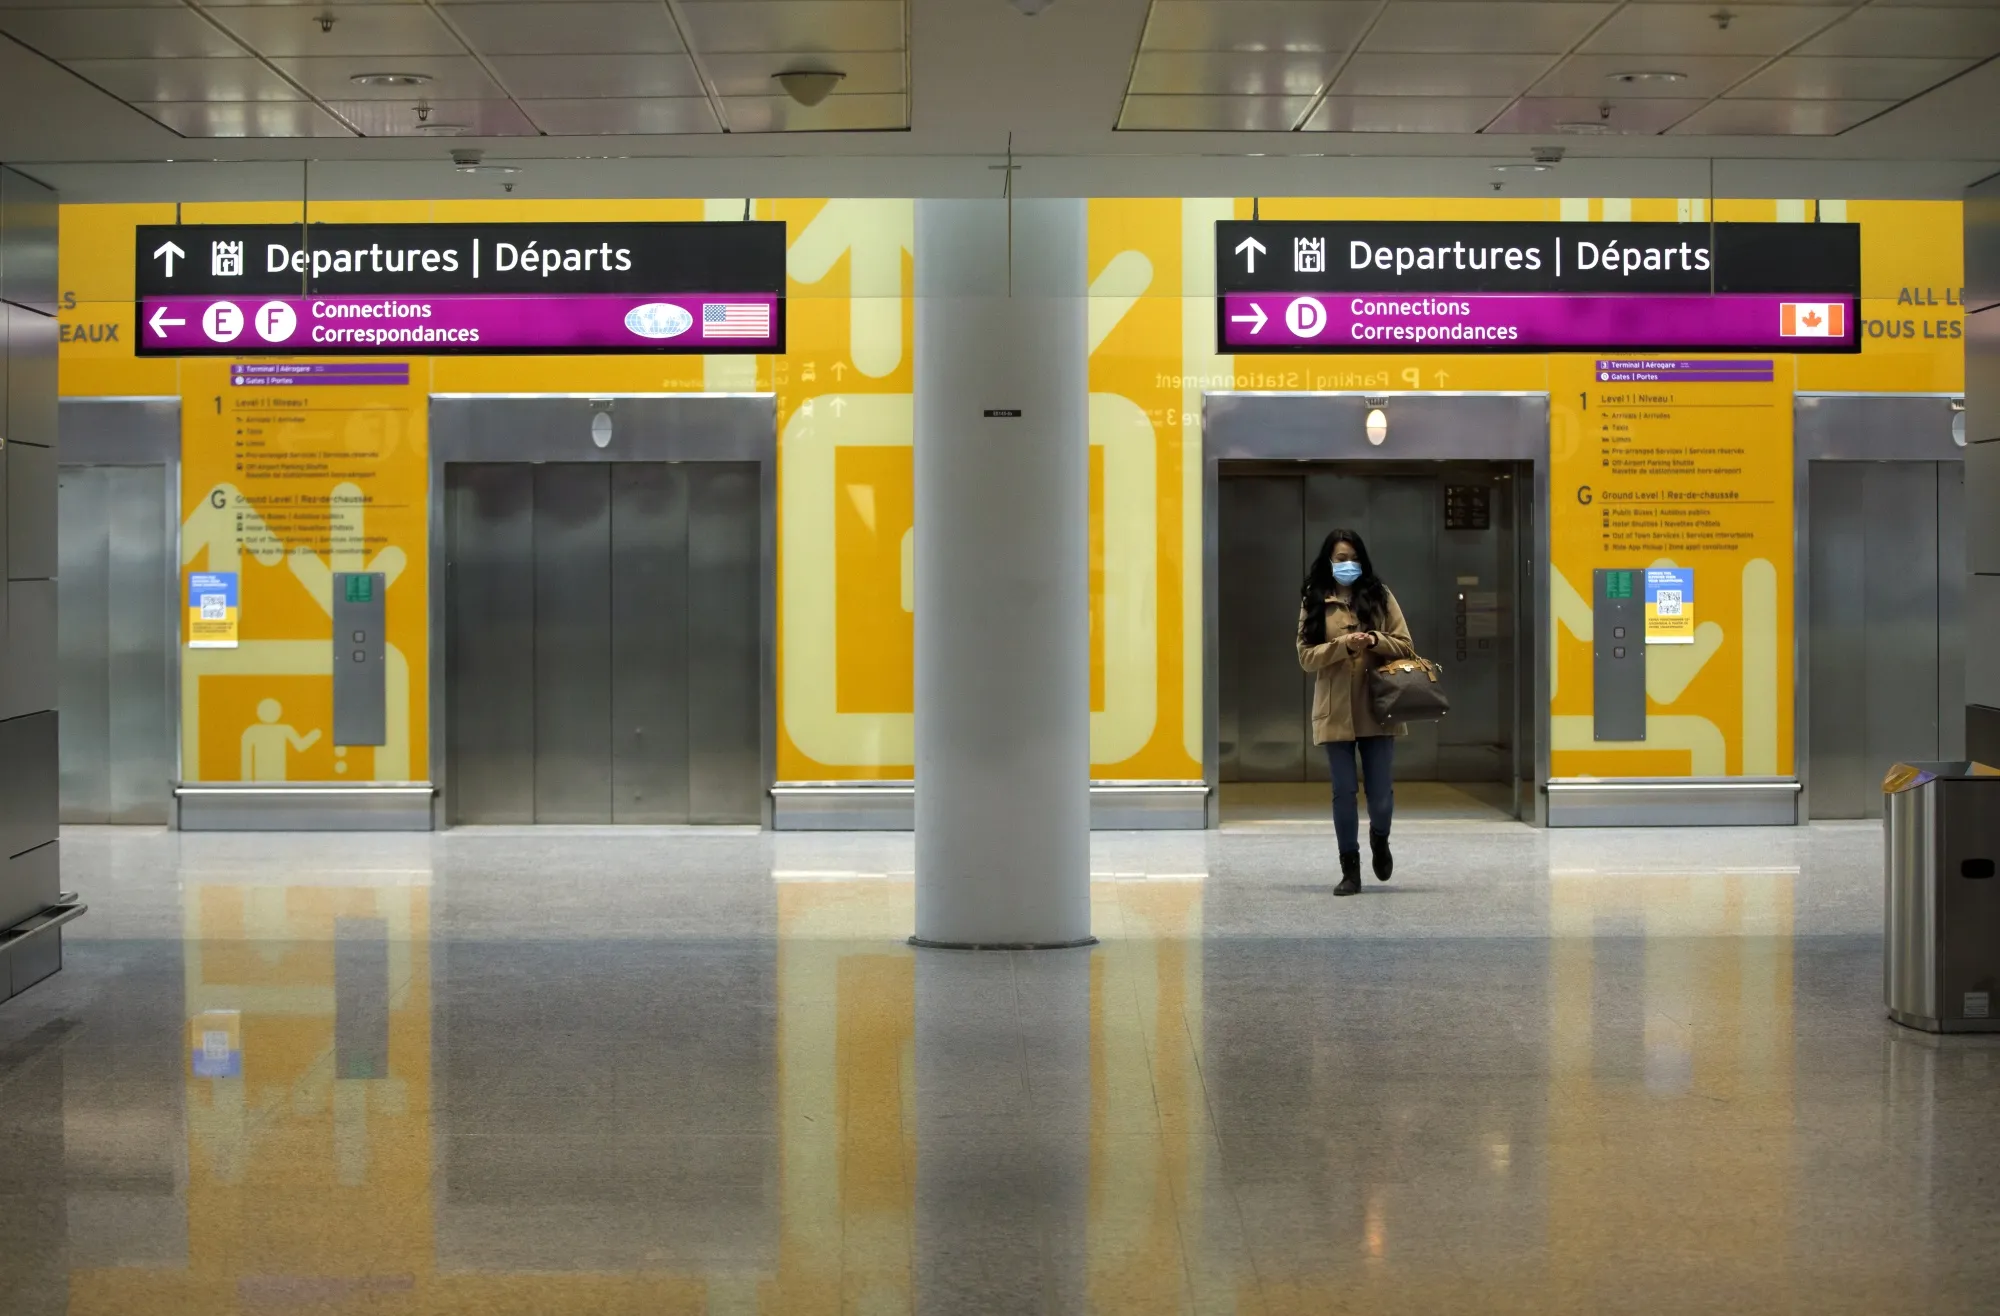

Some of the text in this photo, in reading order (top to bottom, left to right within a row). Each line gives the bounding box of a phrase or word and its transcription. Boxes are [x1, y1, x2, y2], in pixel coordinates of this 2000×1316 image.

[266, 240, 632, 279] Departures Départs
[1350, 239, 1711, 277] Departures Départs
[1898, 288, 1939, 306] ALL
[312, 300, 432, 319] Connections
[1350, 298, 1470, 316] Connections
[216, 308, 284, 335] E F
[1298, 304, 1318, 330] D
[312, 326, 480, 346] Correspondances
[1351, 322, 1518, 343] Correspondances
[1924, 320, 1962, 339] LES
[215, 396, 221, 415] 1
[1580, 392, 1587, 410] 1
[1602, 395, 1624, 403] Level
[1639, 395, 1667, 403] Niveau
[211, 490, 226, 509] G
[1578, 486, 1592, 505] G
[1602, 491, 1739, 499] Ground Level Rez-de-chaussée
